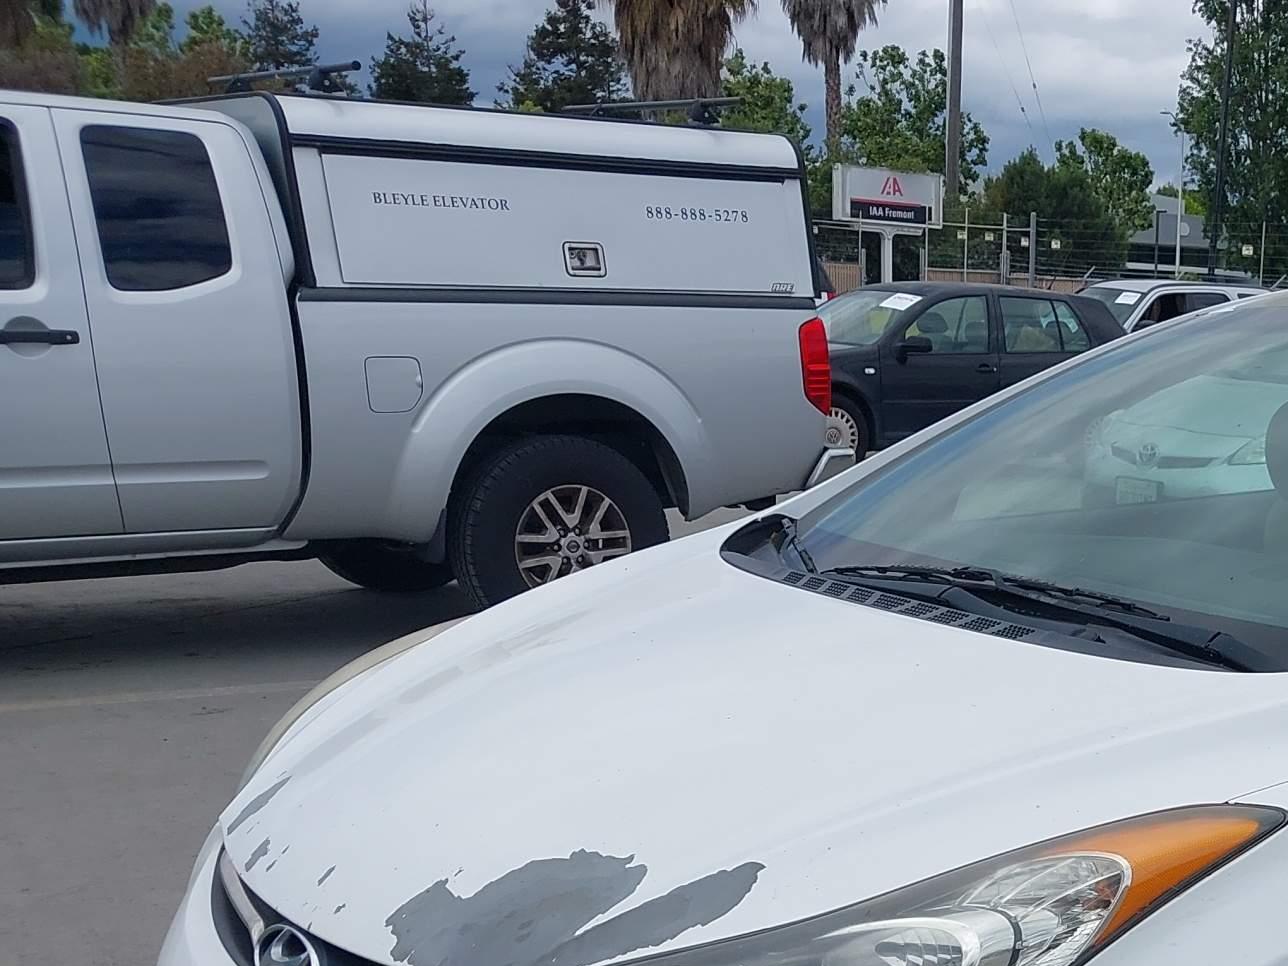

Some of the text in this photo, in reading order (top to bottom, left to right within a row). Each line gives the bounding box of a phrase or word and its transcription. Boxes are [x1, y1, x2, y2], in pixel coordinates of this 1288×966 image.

[372, 191, 510, 211] BLEYLE ELEVATOR
[645, 205, 749, 223] 888-888-5278
[869, 206, 915, 219] IAA Fremont
